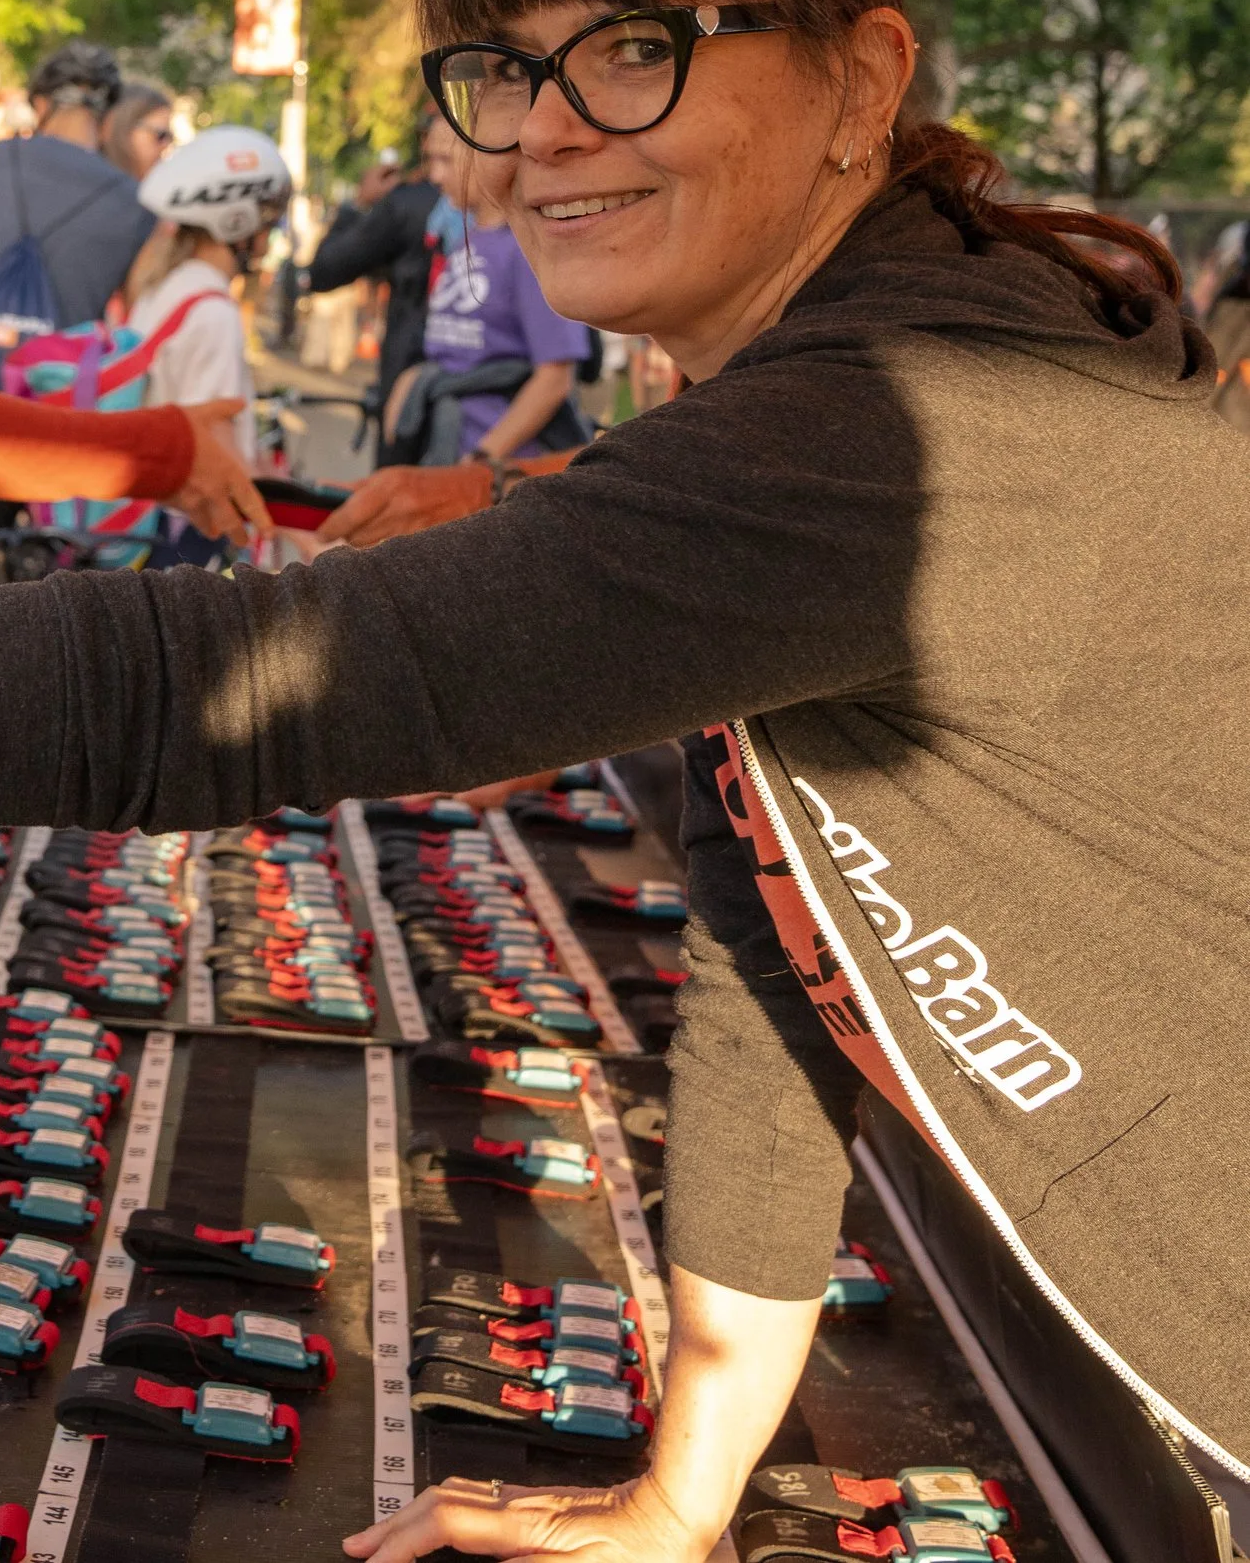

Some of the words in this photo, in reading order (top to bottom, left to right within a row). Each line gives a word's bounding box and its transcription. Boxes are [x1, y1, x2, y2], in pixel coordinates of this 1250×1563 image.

[102, 1285, 125, 1300] 150
[378, 1309, 398, 1325] 170
[379, 1343, 399, 1359] 169
[383, 1379, 405, 1395] 168
[383, 1416, 406, 1433] 167
[383, 1455, 406, 1473] 166
[49, 1464, 76, 1483] 145
[378, 1495, 402, 1515] 165
[42, 1506, 70, 1525] 144
